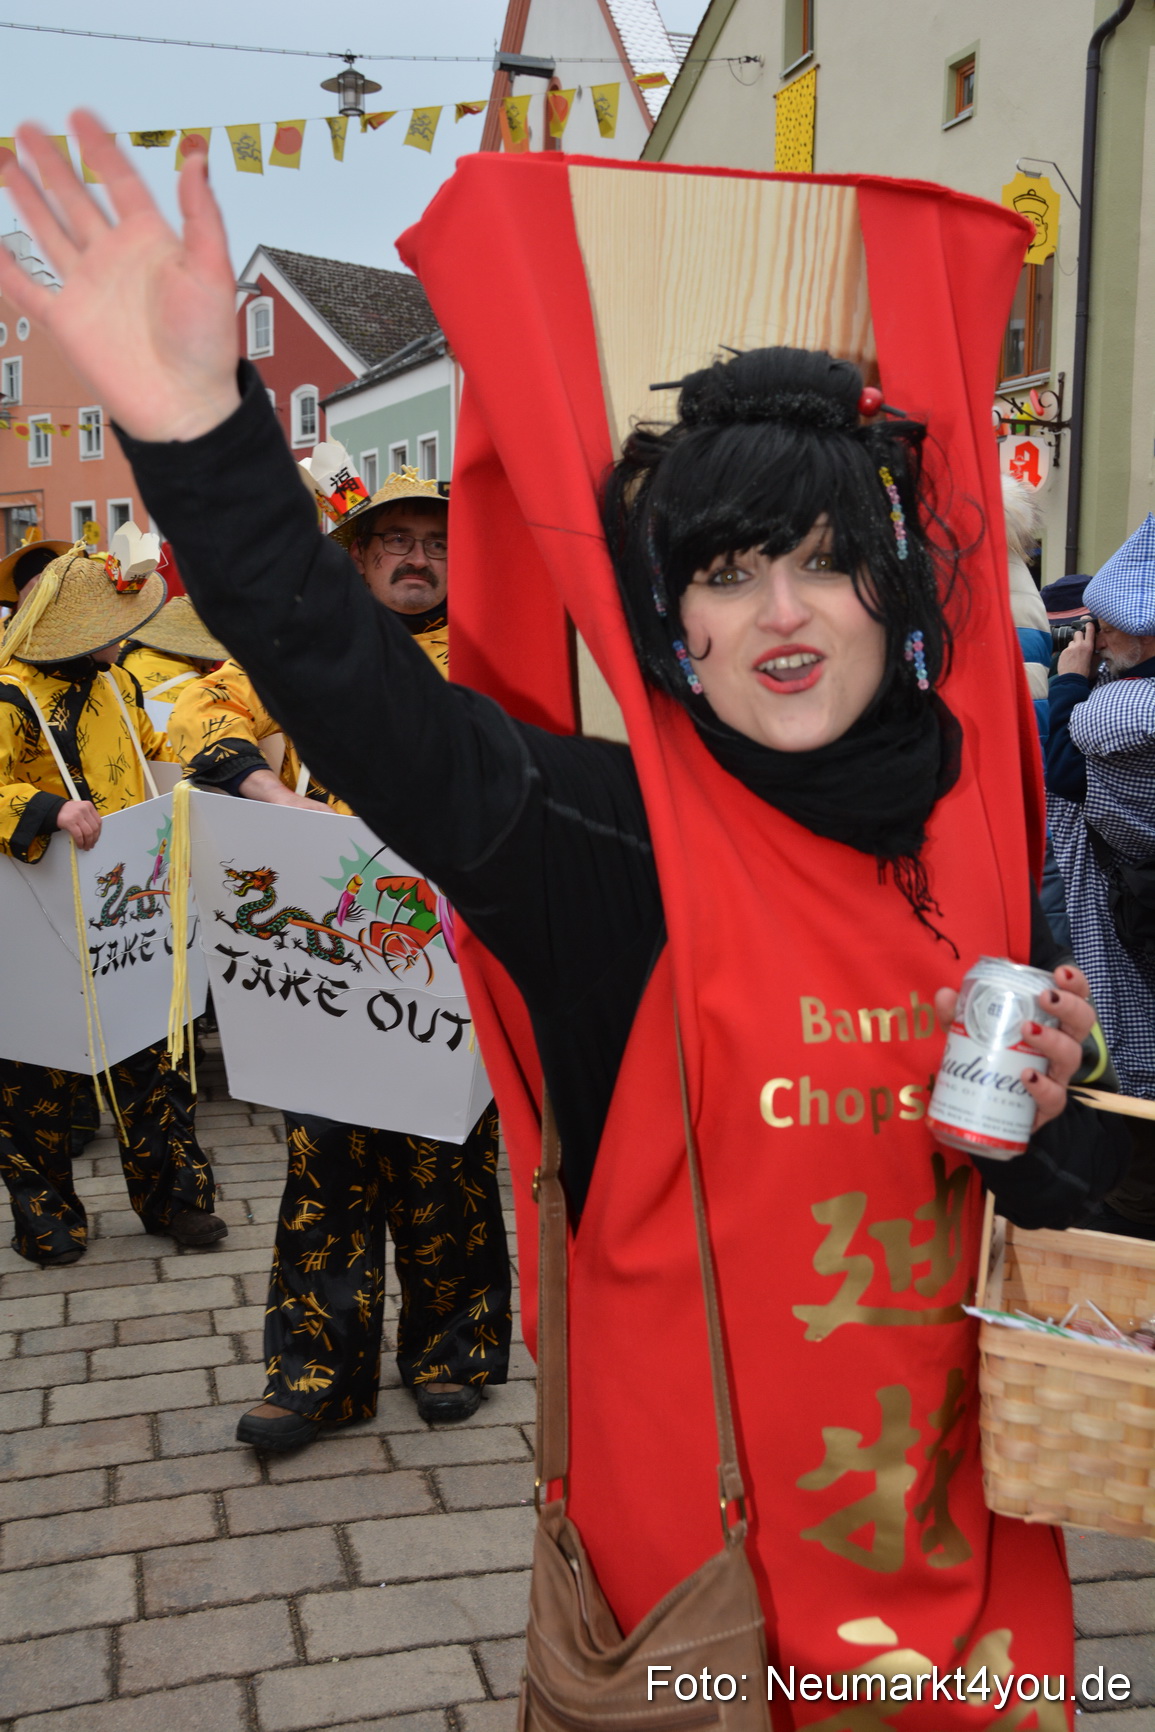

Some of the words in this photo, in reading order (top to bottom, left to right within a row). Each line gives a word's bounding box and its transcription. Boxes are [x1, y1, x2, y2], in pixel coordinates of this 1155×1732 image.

[89, 929, 157, 978] TAKE
[214, 942, 349, 1018] TAKE
[366, 990, 472, 1052] OUT
[799, 990, 949, 1044] Bamb
